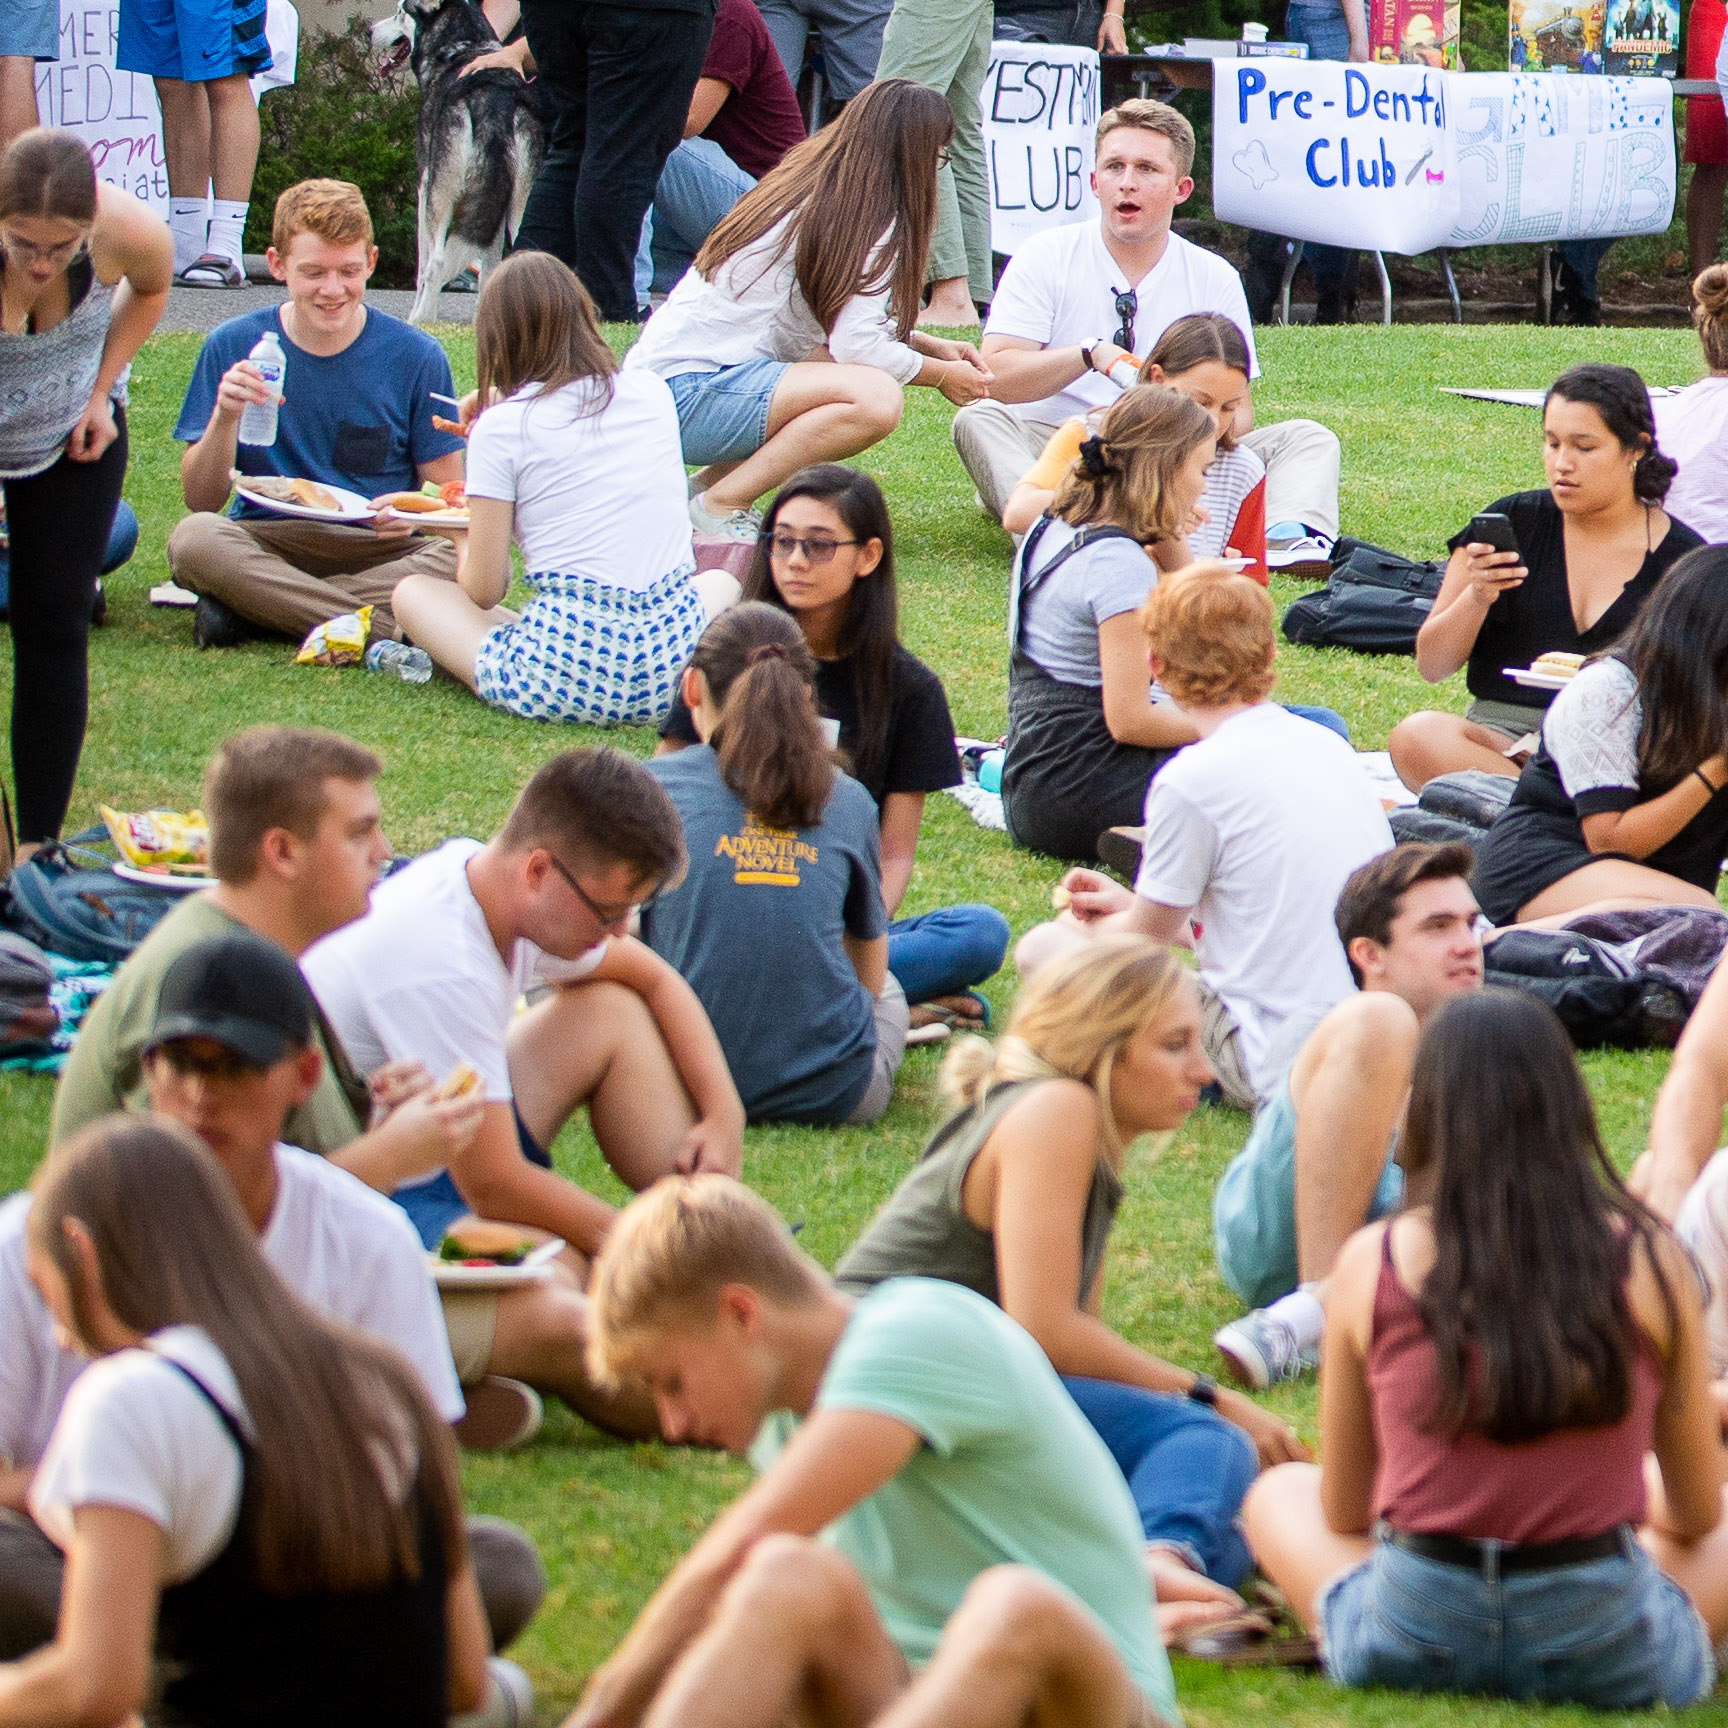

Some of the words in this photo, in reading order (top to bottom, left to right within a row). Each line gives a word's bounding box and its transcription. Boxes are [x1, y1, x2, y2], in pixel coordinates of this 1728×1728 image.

[1611, 39, 1673, 53] PANDEMIC
[1237, 67, 1446, 130] Pre-Dental
[1456, 75, 1666, 145] GAME
[991, 139, 1082, 212] LUB
[1306, 136, 1396, 188] Club
[1450, 131, 1671, 241] CLUB
[714, 835, 819, 864] ADVENTURE
[735, 855, 800, 874] NOVEL
